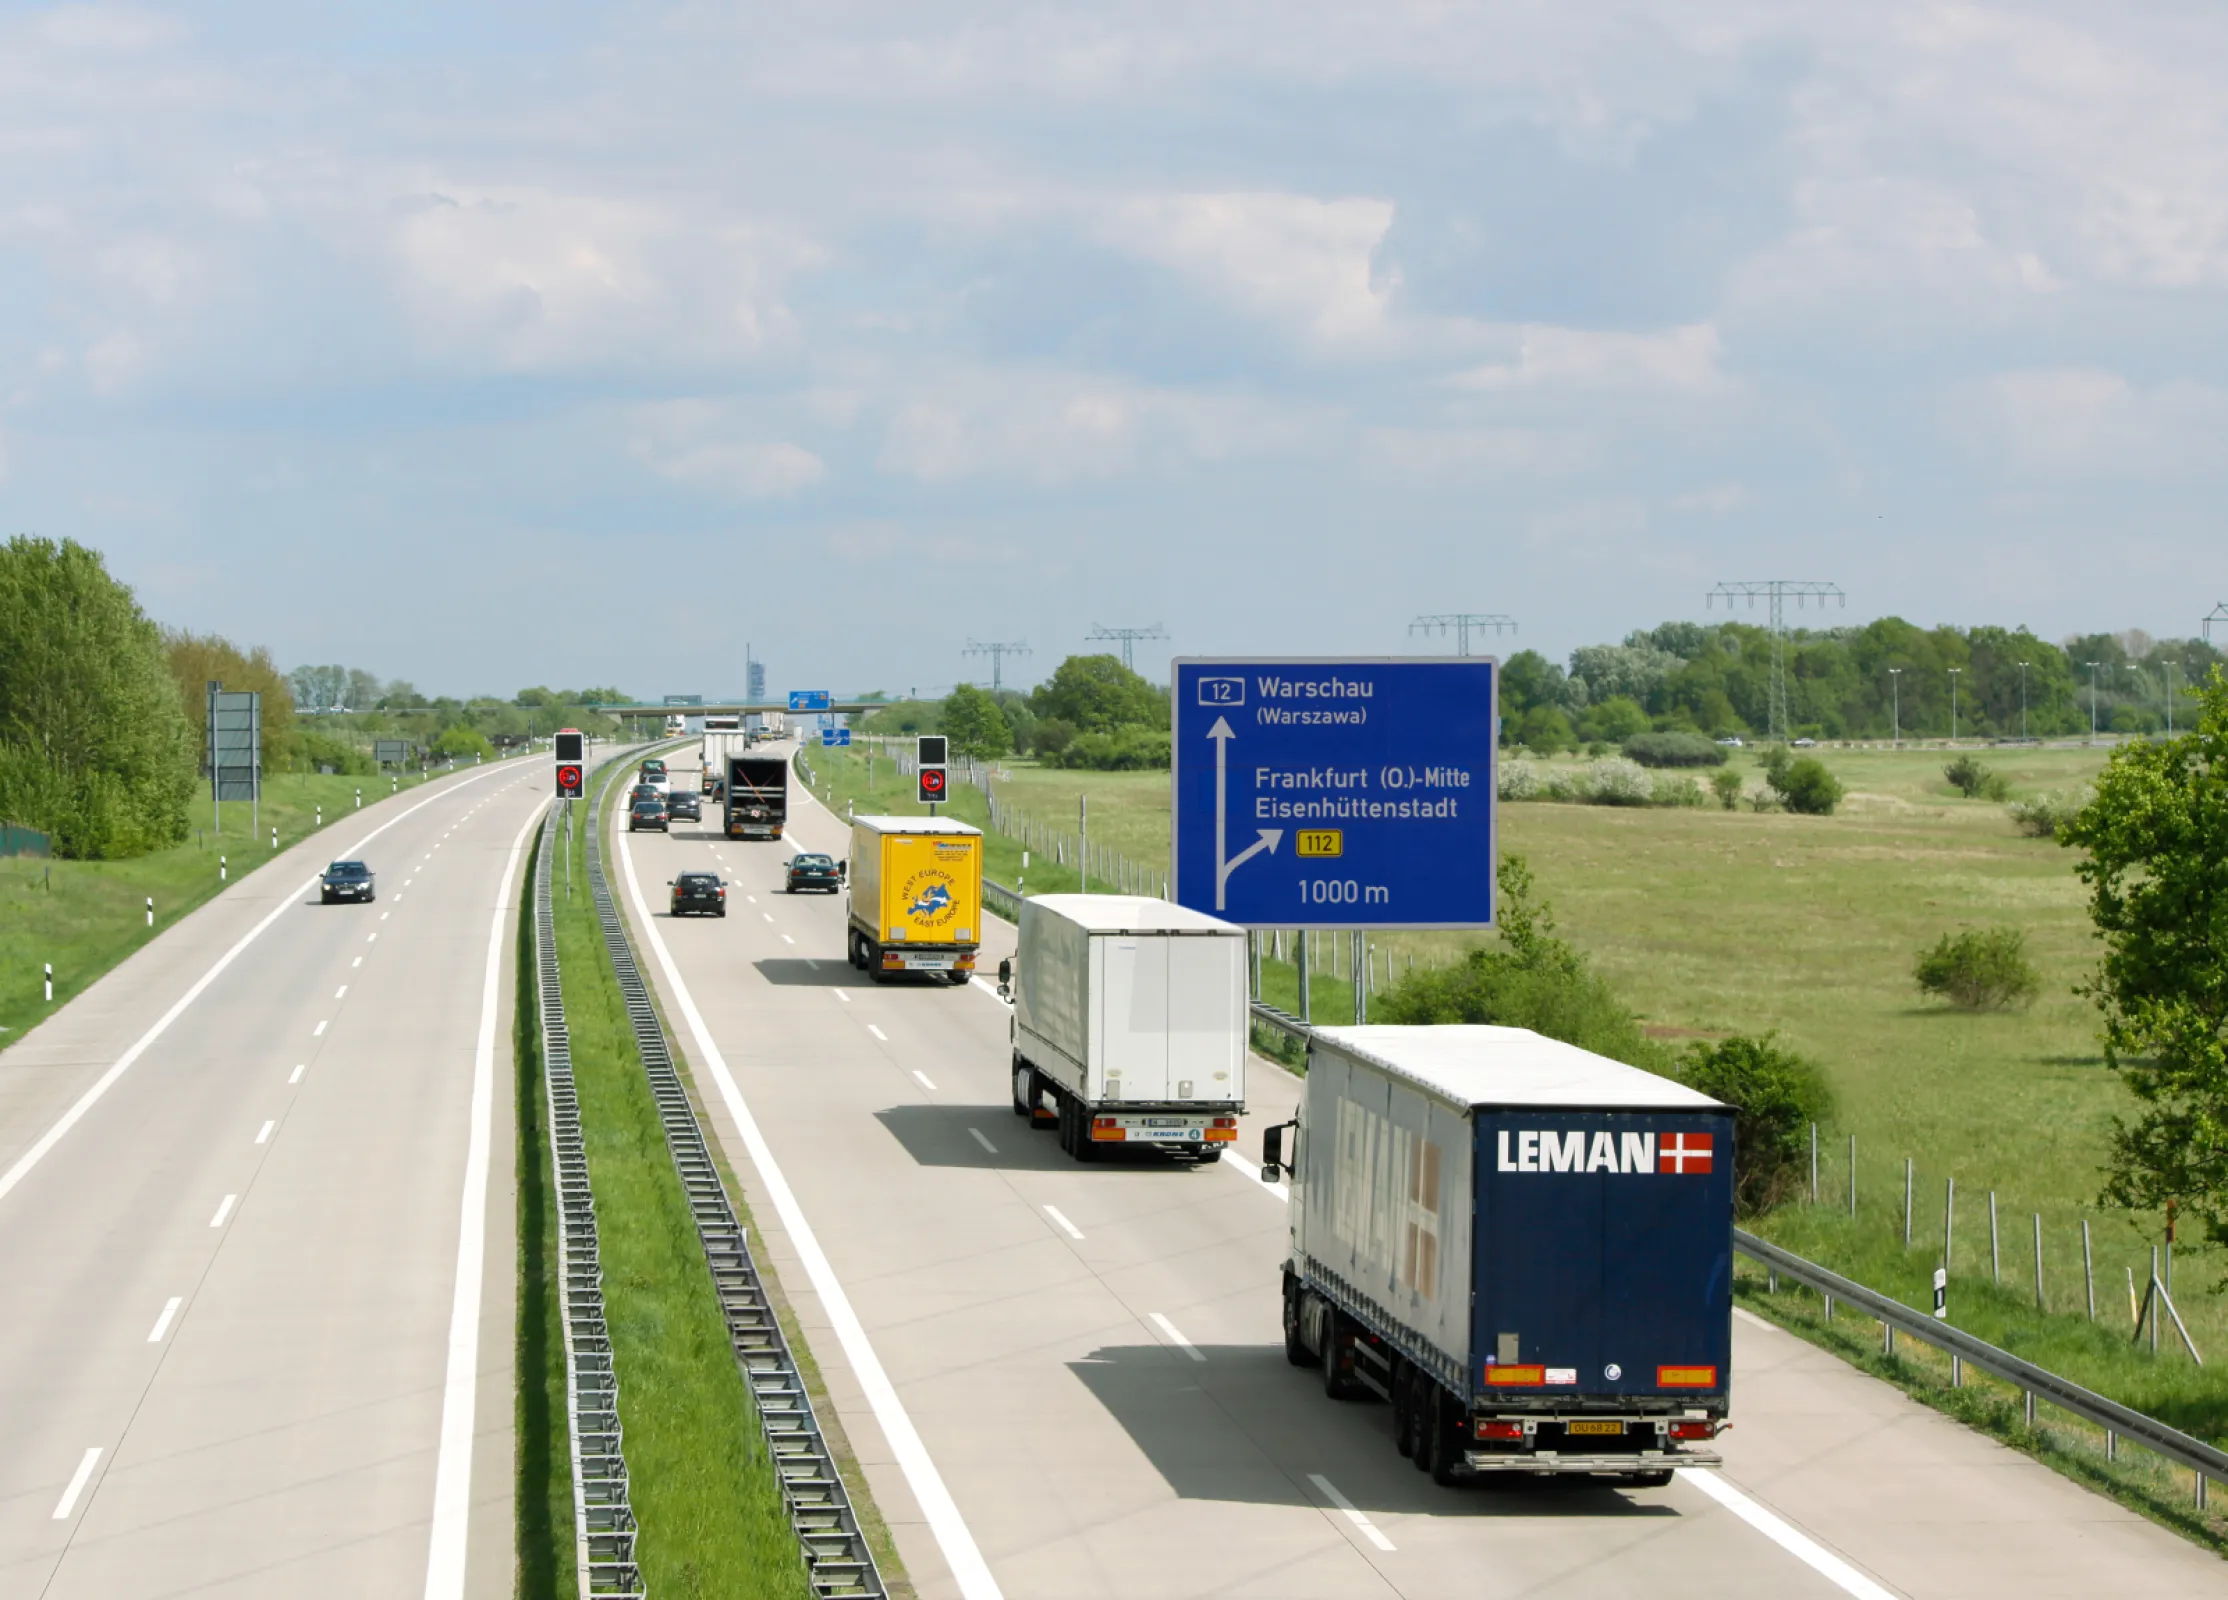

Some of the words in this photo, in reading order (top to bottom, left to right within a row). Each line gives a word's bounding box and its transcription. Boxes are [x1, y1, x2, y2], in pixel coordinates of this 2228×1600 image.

[1212, 683, 1231, 700] 12
[1257, 676, 1374, 698] Warschau
[1256, 706, 1367, 725] (Warszawa)
[1255, 767, 1368, 788] Frankfurt
[1380, 767, 1470, 789] (O.)-Mitte
[1255, 797, 1458, 818] Eisenhüttenstadt
[1306, 835, 1333, 852] 112
[902, 875, 917, 900] WEST
[918, 869, 955, 886] EUROPE
[1298, 880, 1359, 903] 1000
[1365, 885, 1389, 903] m
[914, 917, 935, 928] EAST
[937, 900, 960, 927] EUROPE
[1498, 1130, 1655, 1174] LEMAN
